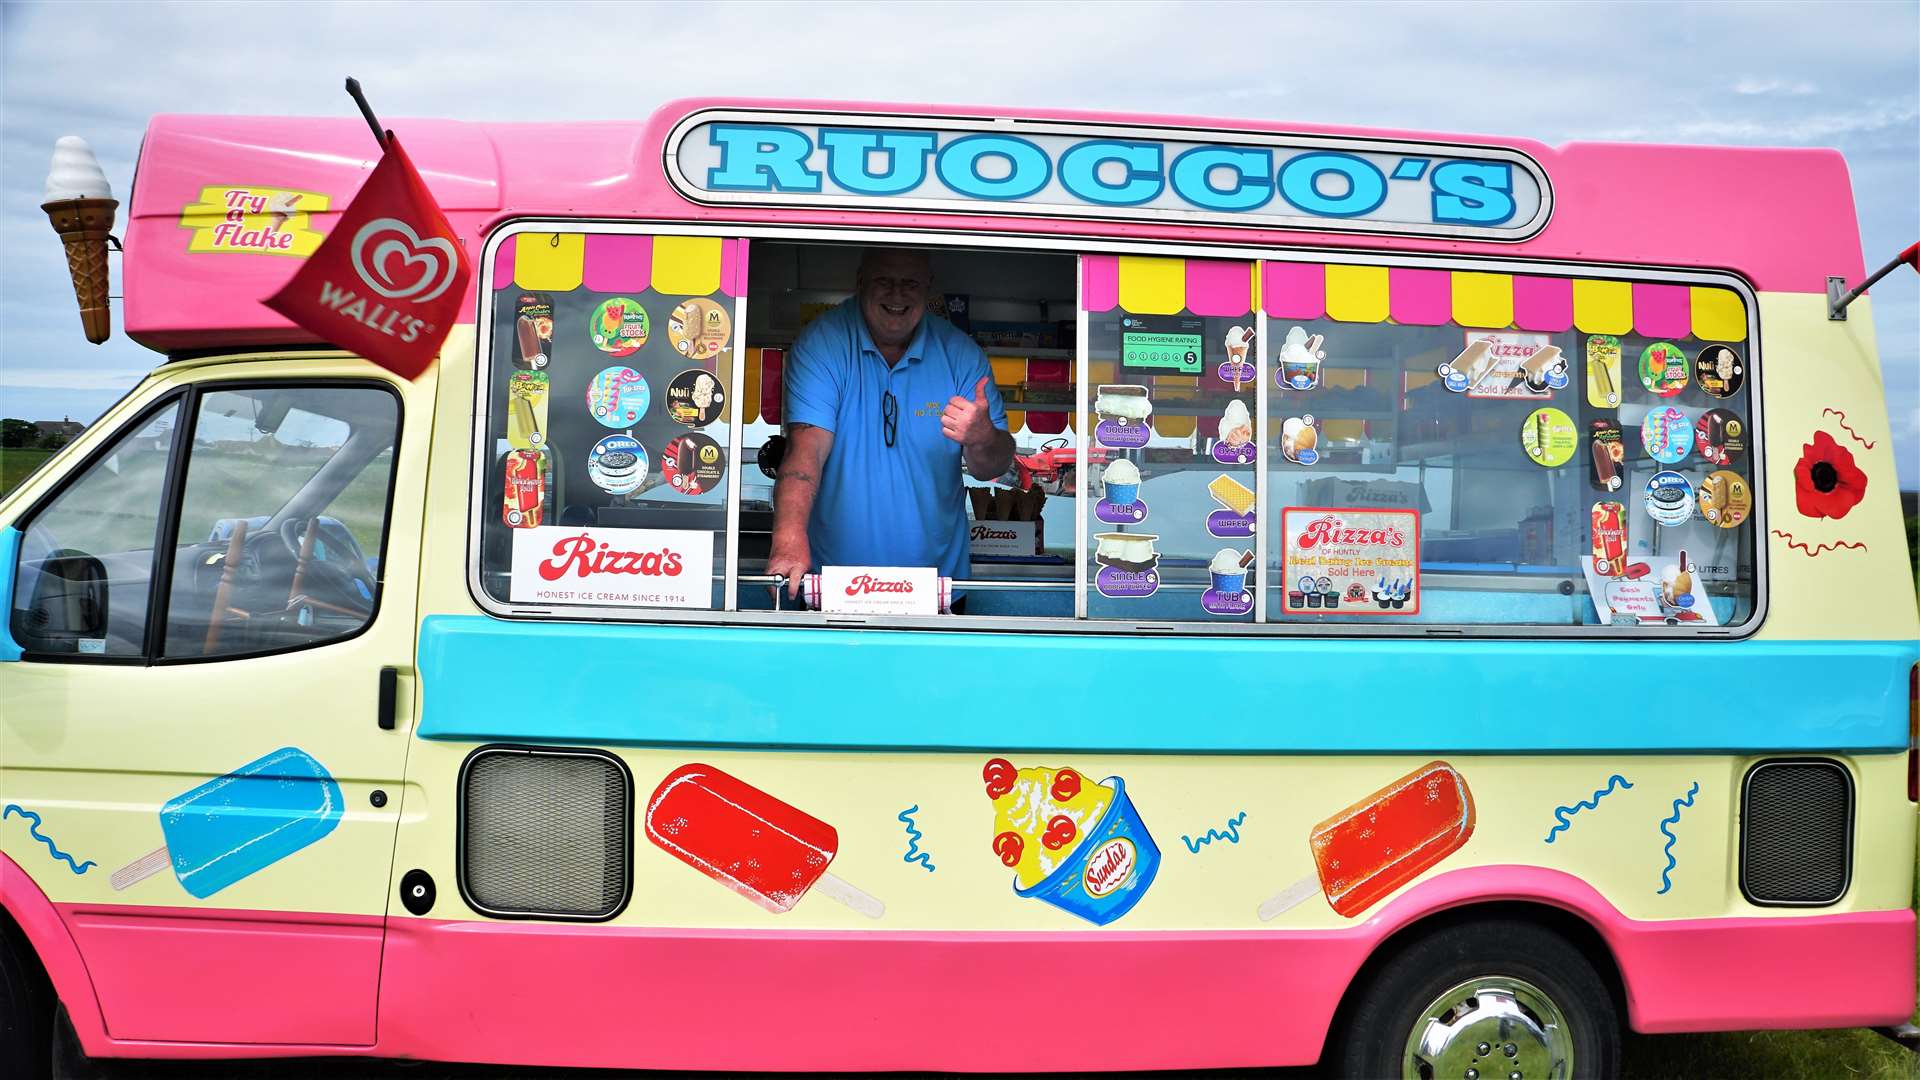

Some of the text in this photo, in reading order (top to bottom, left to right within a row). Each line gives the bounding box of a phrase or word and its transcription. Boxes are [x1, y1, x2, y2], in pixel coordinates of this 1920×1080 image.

[707, 123, 1517, 227] RUOCCO'S
[225, 190, 267, 214] Try
[226, 207, 244, 222] a
[213, 223, 294, 250] Flake
[318, 280, 427, 343] WALL'S
[620, 329, 645, 338] STOCK
[1187, 353, 1194, 363] 5
[1478, 386, 1498, 394] Sold
[607, 441, 637, 449] OREO
[1109, 504, 1133, 514] TUB
[1218, 520, 1249, 528] WAFER
[970, 525, 1017, 541] Rizza's
[1298, 515, 1405, 549] Rizza's
[538, 532, 683, 581] Rizza's
[1355, 557, 1374, 566] Ice
[1328, 567, 1375, 577] Sold Here
[1698, 566, 1729, 574] LITRES
[1110, 572, 1145, 581] SINGLE
[845, 573, 914, 596] Rizza's
[536, 590, 686, 603] HONEST ICE CREAM SINCE 1914
[1216, 591, 1240, 602] TUB
[1087, 842, 1127, 892] Sundae
